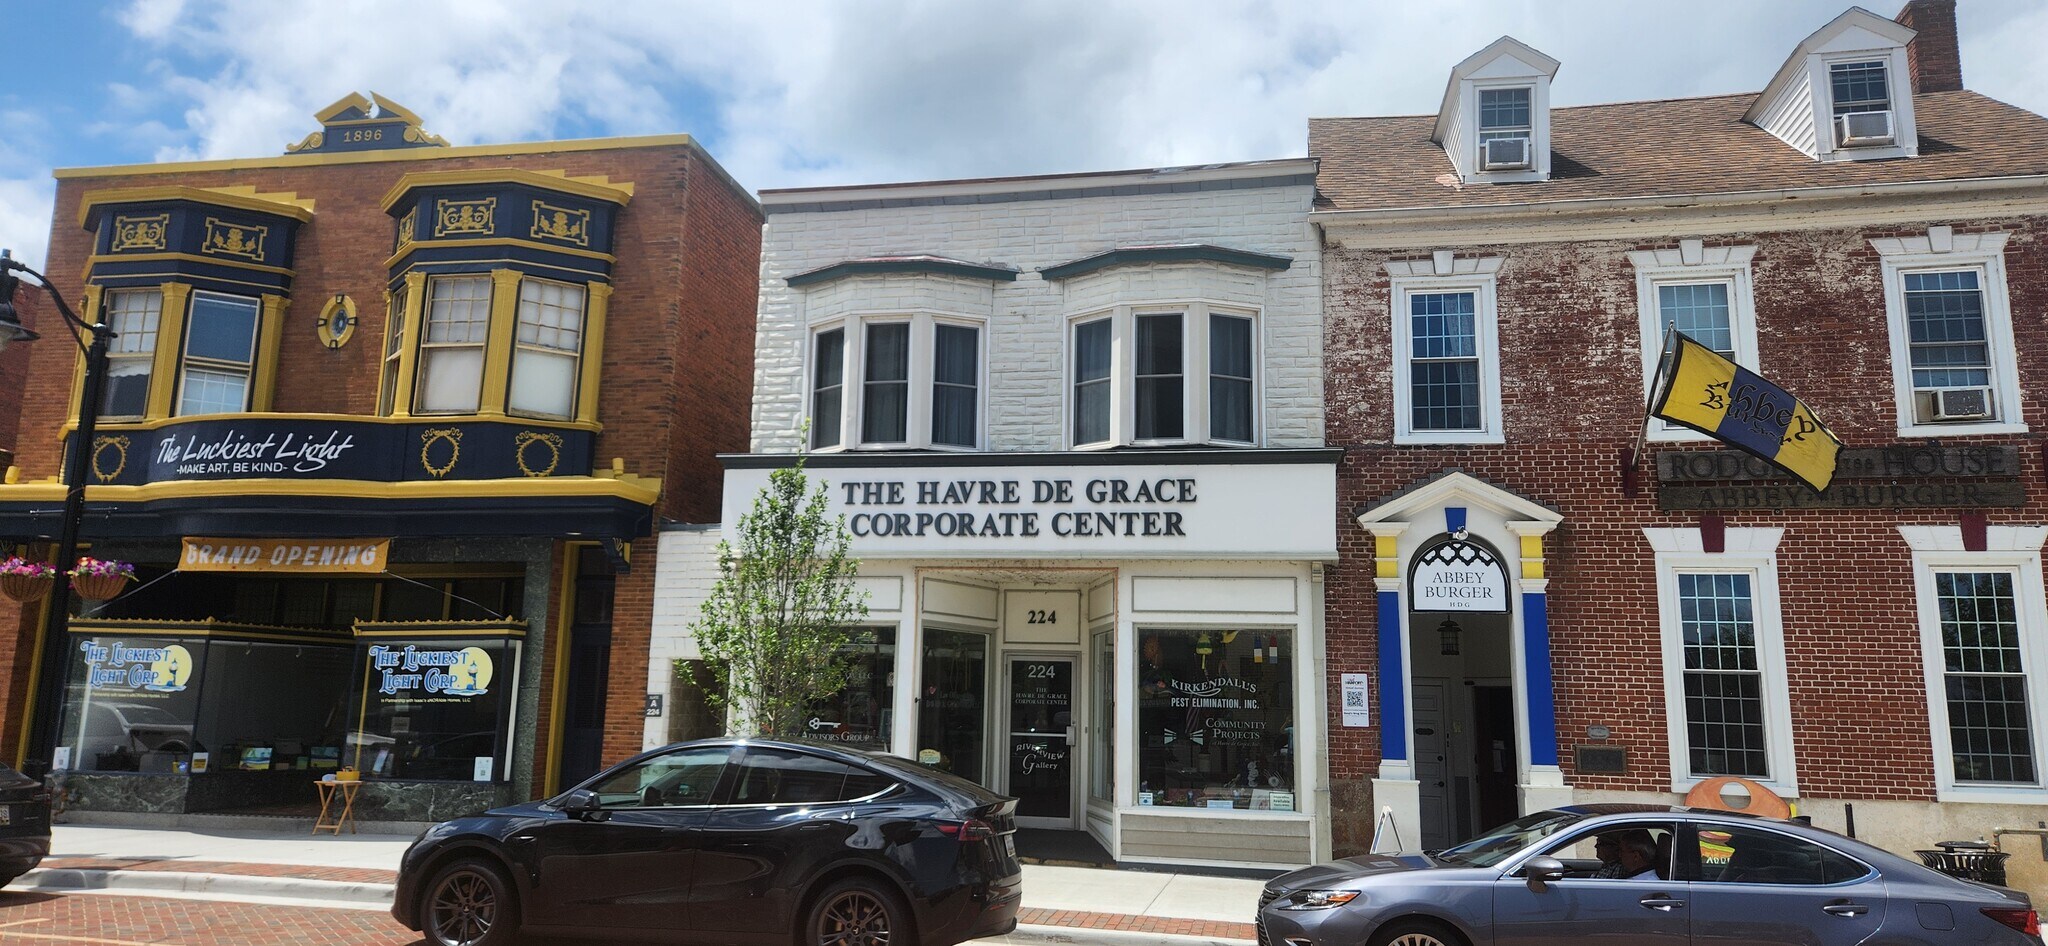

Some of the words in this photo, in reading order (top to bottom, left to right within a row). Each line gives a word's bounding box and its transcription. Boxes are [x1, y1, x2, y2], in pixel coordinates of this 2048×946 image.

[343, 129, 382, 143] 1896
[157, 433, 182, 464] The
[181, 429, 276, 461] Luckiest
[275, 430, 354, 473] Light
[207, 463, 231, 474] ART,
[233, 462, 249, 473] BE
[1841, 457, 1873, 470] 788
[1882, 447, 2006, 475] HOUSE
[842, 481, 905, 505] THE
[916, 480, 1021, 504] HAVRE
[1032, 479, 1074, 504] DE
[1085, 478, 1198, 504] GRACE
[1699, 486, 1802, 508] ABBEY
[1840, 484, 1987, 507] BURGER
[850, 512, 1040, 538] CORPORATE
[1051, 511, 1186, 537] CENTER
[186, 544, 260, 565] GRAND
[270, 545, 377, 566] OPENING
[1432, 571, 1485, 584] ABBEY
[1425, 586, 1493, 599] BURGER
[1027, 610, 1057, 624] 224
[80, 641, 108, 665] THE
[109, 641, 171, 667] LUCKIEST
[369, 645, 401, 670] THE
[402, 645, 469, 672] LUCKIEST
[89, 663, 127, 688] LIGHT
[1028, 664, 1055, 678] 224
[378, 668, 422, 694] LIGHT
[1171, 678, 1257, 693] KIRKENDALL'S
[1171, 697, 1189, 708] PEST
[1192, 698, 1241, 709] ELIMINATION,
[1244, 699, 1260, 709] INC.
[1205, 718, 1267, 729] COMMUNITY
[801, 731, 840, 741] ADVISORS
[841, 731, 870, 741] GROUP
[1213, 729, 1260, 740] PROJECTS
[1016, 743, 1065, 760] RIVERVIEW
[1022, 753, 1058, 775] Gallery
